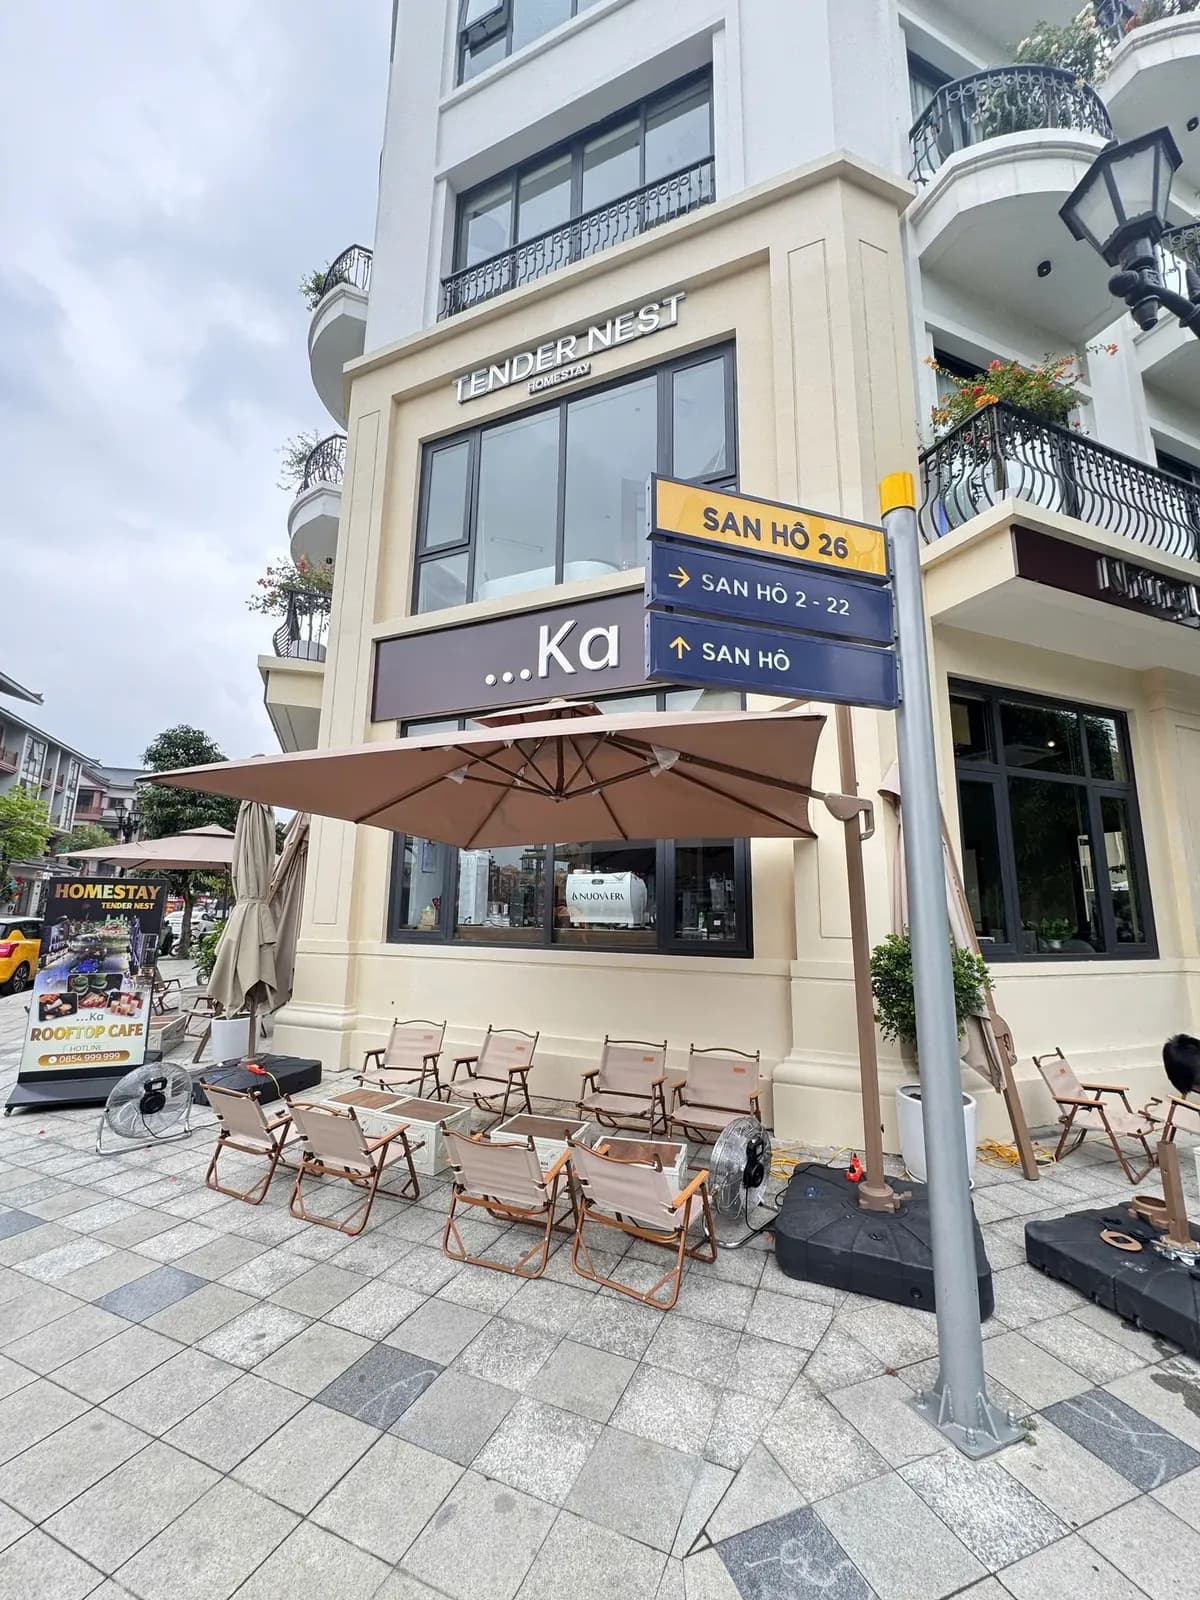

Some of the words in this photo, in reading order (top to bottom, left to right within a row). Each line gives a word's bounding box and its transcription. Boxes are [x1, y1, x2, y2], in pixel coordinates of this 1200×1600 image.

[452, 334, 577, 403] TENDER
[587, 291, 687, 352] NEST
[527, 361, 592, 394] HOMESTAY
[703, 506, 762, 541] SAN
[771, 521, 810, 551] HÔ
[818, 533, 849, 559] 26
[702, 573, 749, 597] SAN
[757, 582, 788, 604] HÔ
[795, 591, 807, 608] 2
[827, 597, 850, 616] 22
[702, 642, 751, 666] SAN
[758, 649, 790, 671] HÔ
[55, 883, 161, 900] HOMESTAY
[101, 901, 132, 909] TENDER
[30, 1025, 106, 1041] ROOFTOP
[108, 1023, 144, 1038] CAFE
[69, 1044, 103, 1052] HOTLINE
